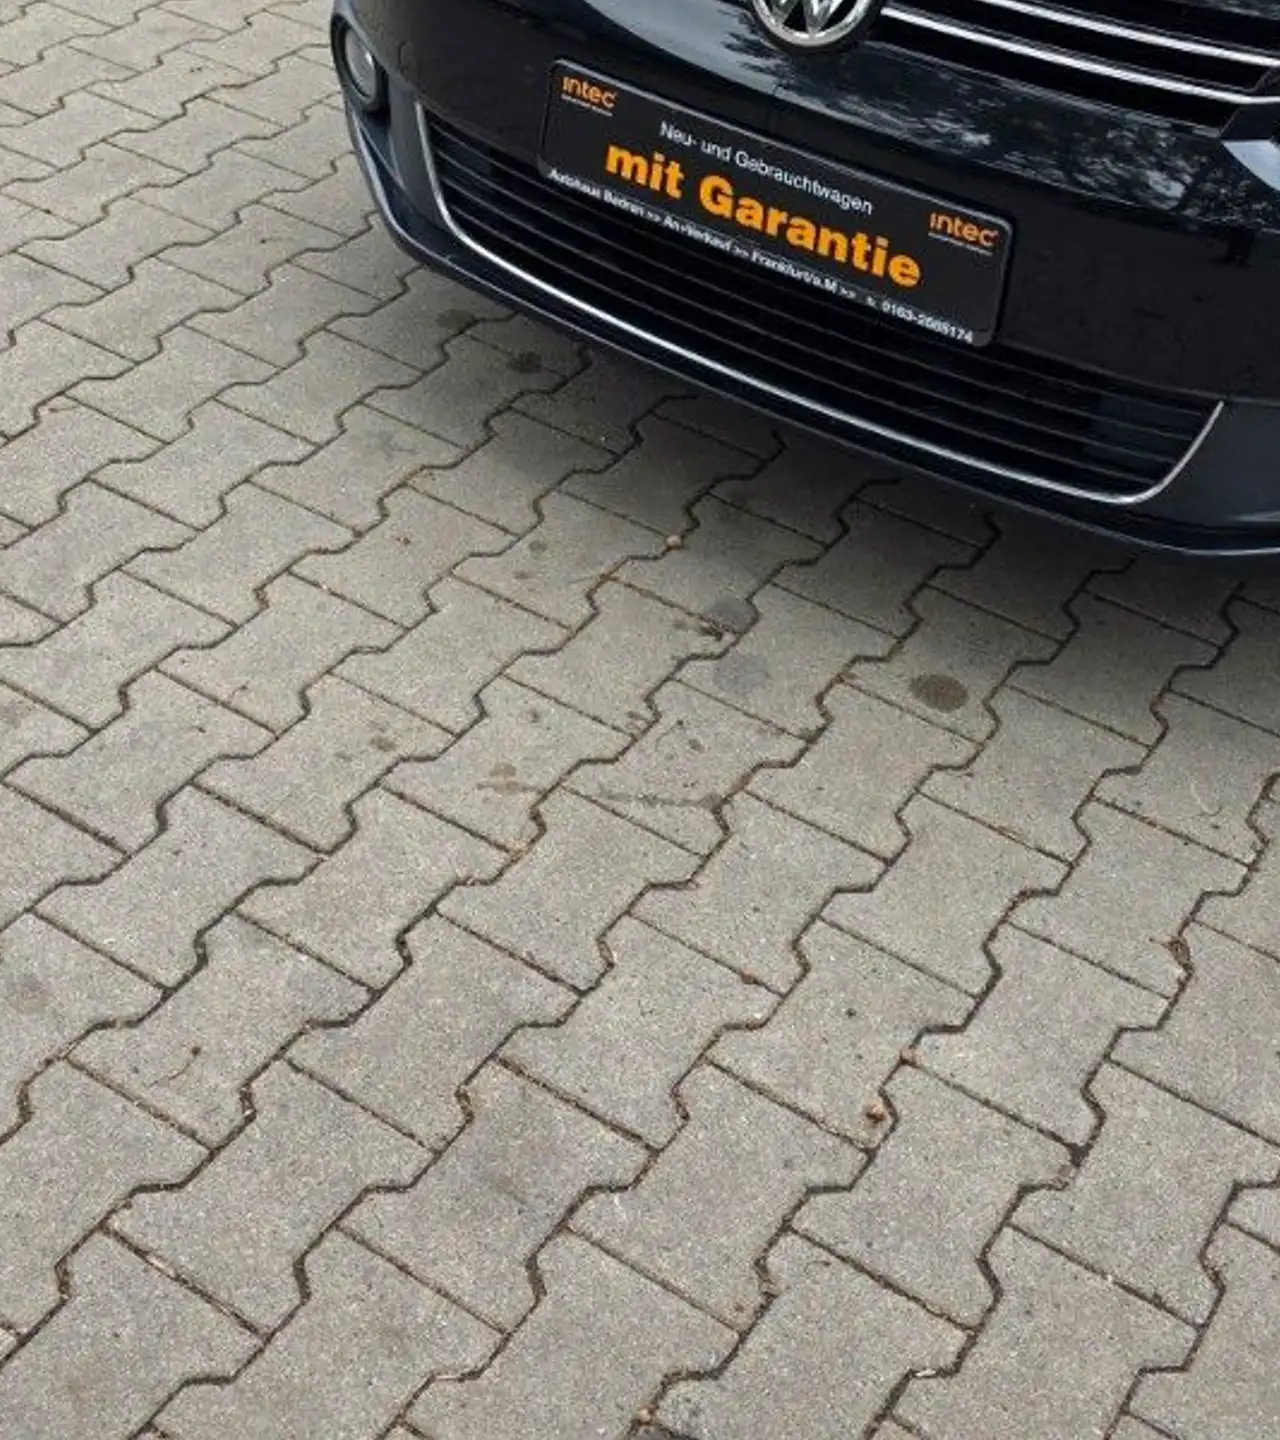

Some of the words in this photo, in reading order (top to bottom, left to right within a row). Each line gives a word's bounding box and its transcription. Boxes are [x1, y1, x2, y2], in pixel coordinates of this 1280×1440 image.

[561, 75, 618, 109] intec
[659, 120, 697, 148] Neu-
[701, 138, 732, 162] und
[734, 150, 873, 215] Gebrauchtwagen
[606, 144, 685, 200] mit
[699, 174, 922, 289] Garantie
[929, 211, 998, 248] intec
